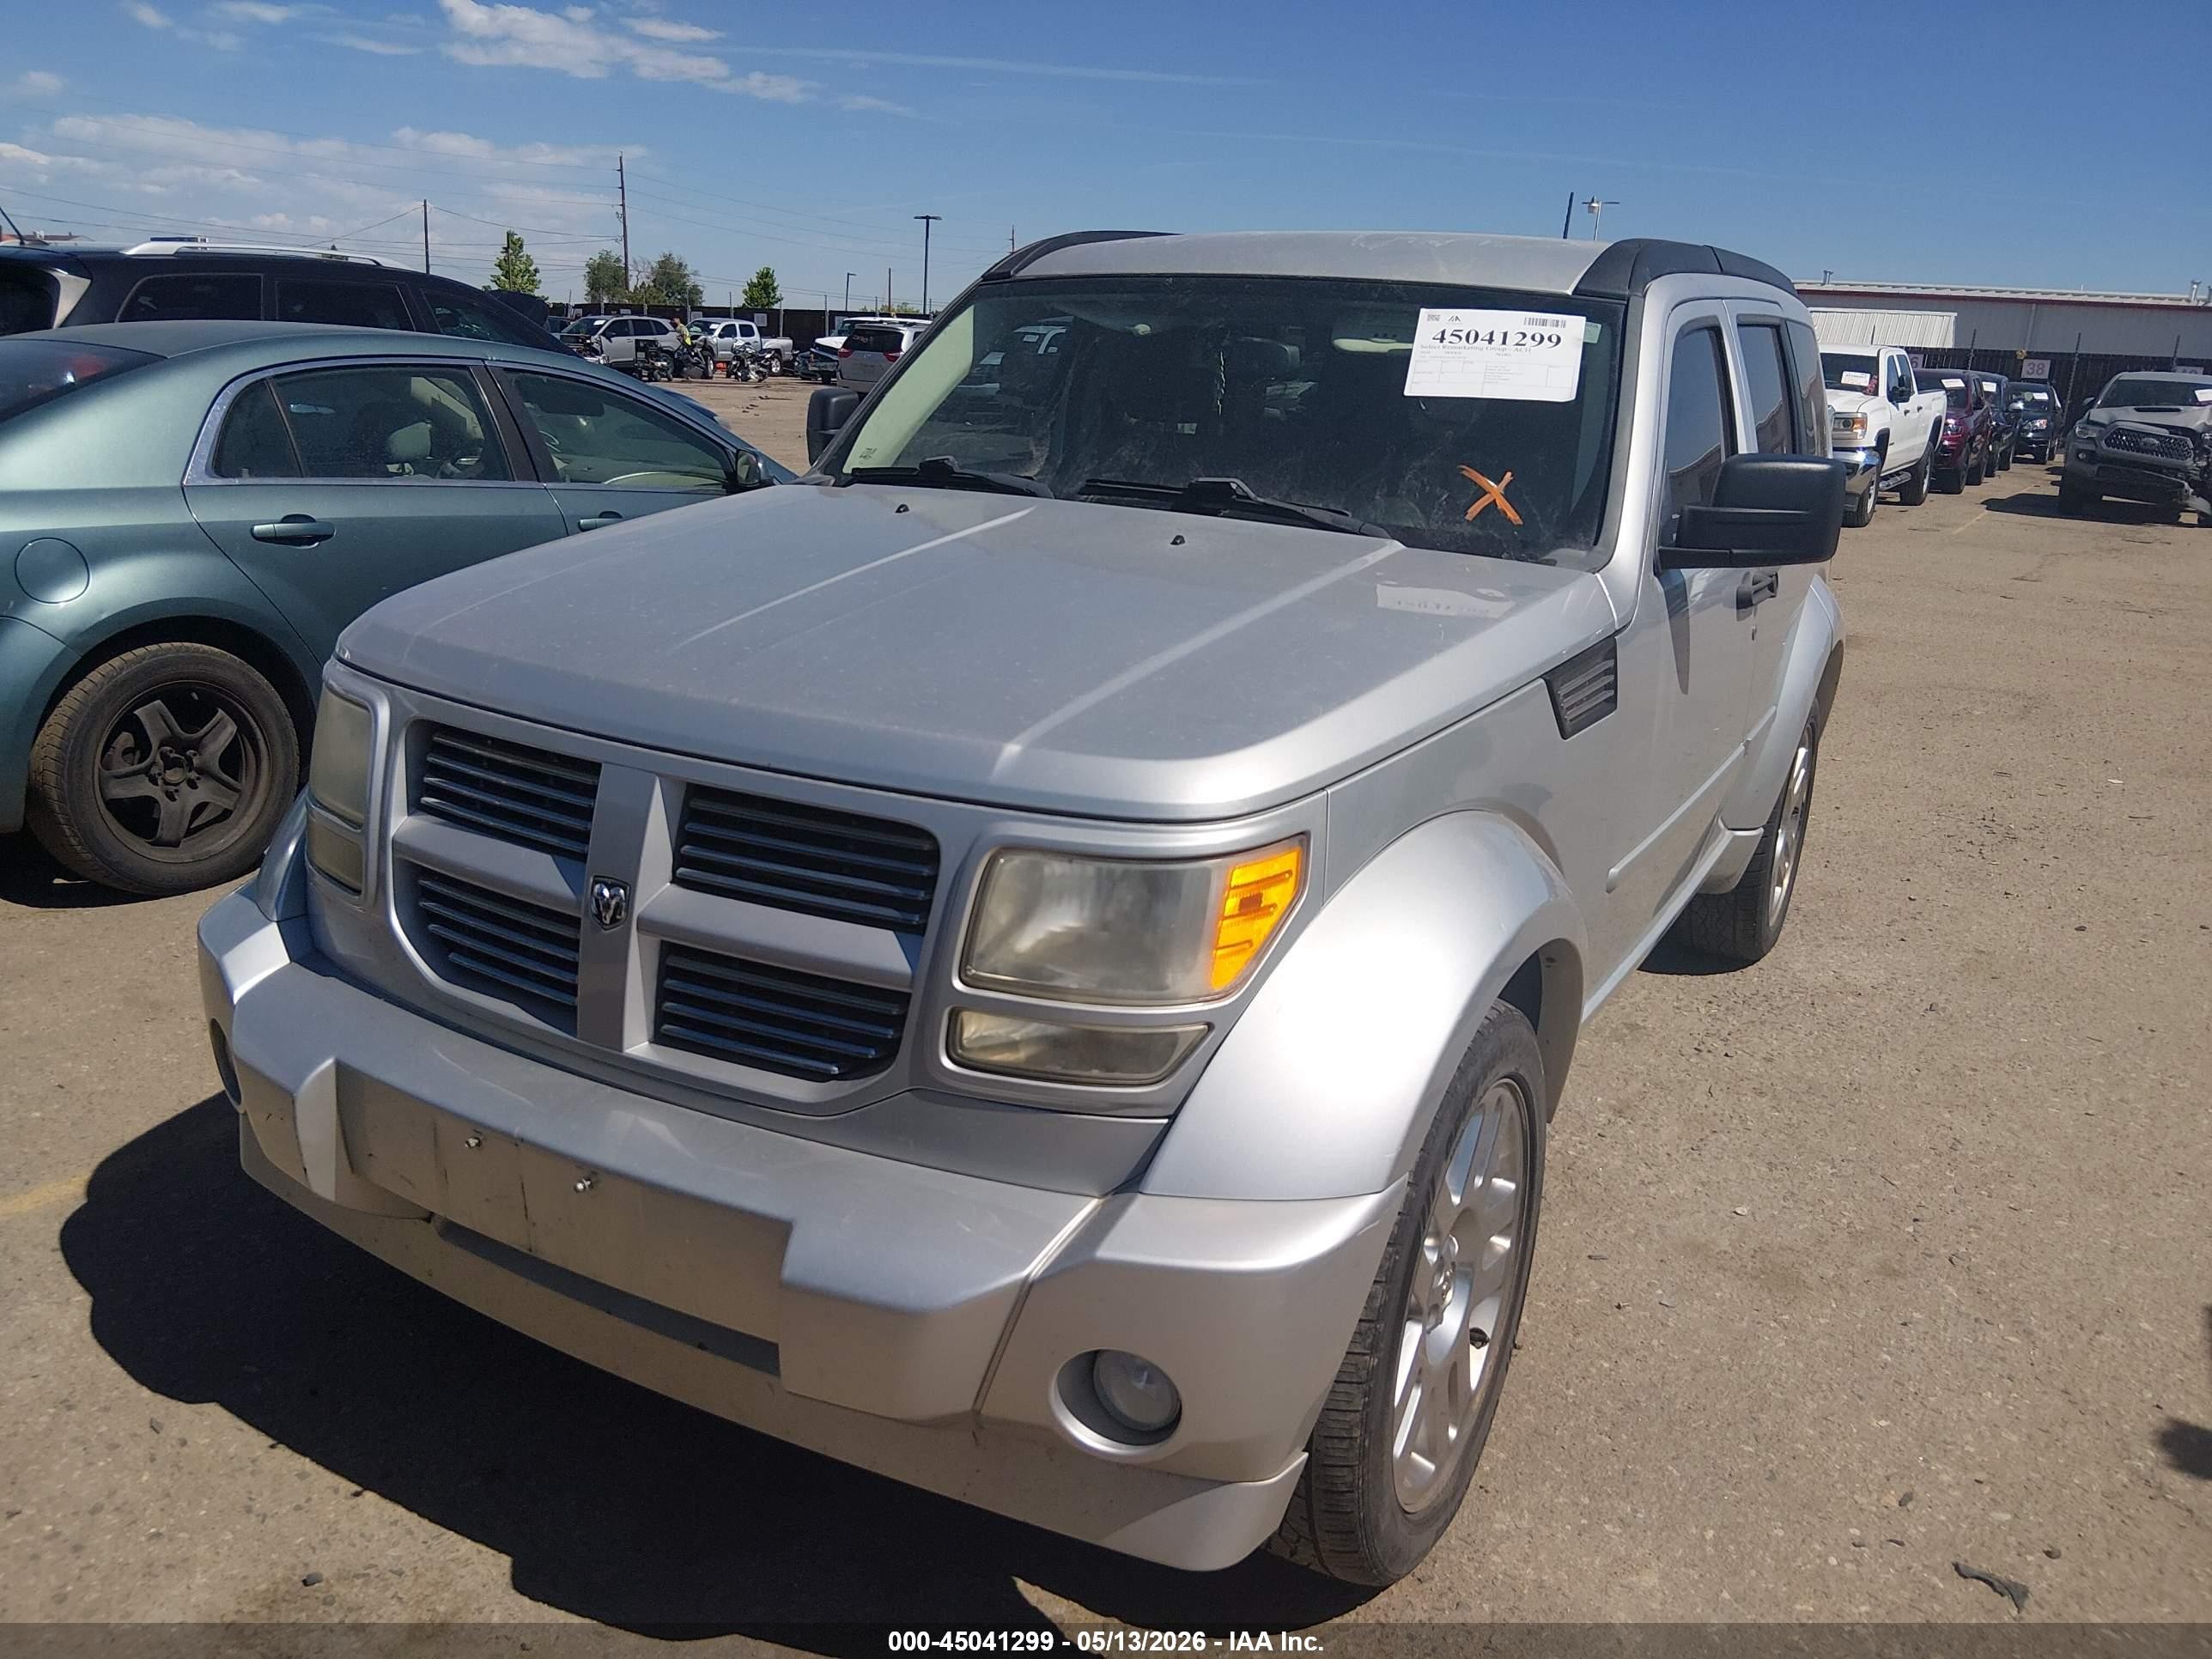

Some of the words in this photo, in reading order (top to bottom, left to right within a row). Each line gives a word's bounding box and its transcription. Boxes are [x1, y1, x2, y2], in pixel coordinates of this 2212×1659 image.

[1431, 329, 1561, 349] 45041299
[1910, 356, 1919, 368] 6
[2026, 362, 2046, 375] 38
